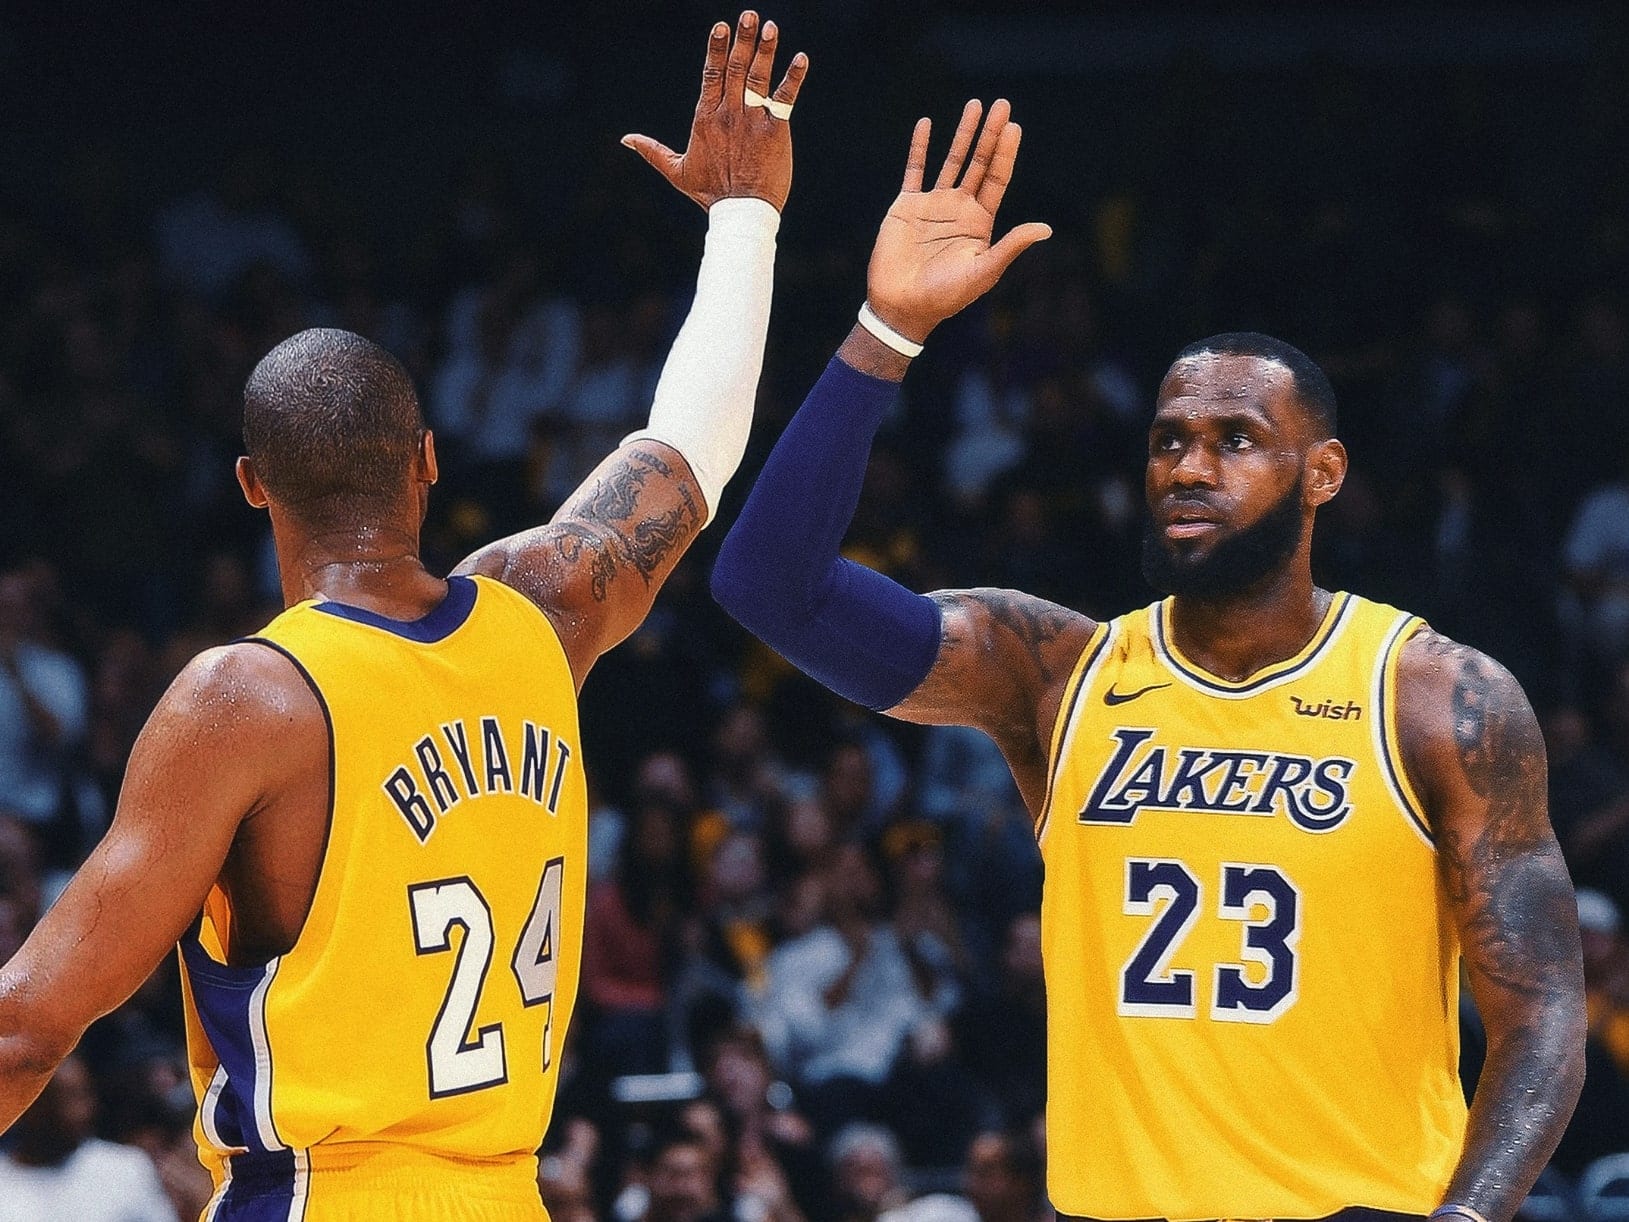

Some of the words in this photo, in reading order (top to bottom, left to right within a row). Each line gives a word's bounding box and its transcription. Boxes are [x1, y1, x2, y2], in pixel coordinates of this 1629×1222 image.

[1290, 696, 1362, 721] wish
[383, 716, 571, 844] BRYANT
[1079, 726, 1355, 833] LAKERS
[407, 856, 564, 1100] 24
[1119, 858, 1300, 1022] 23
